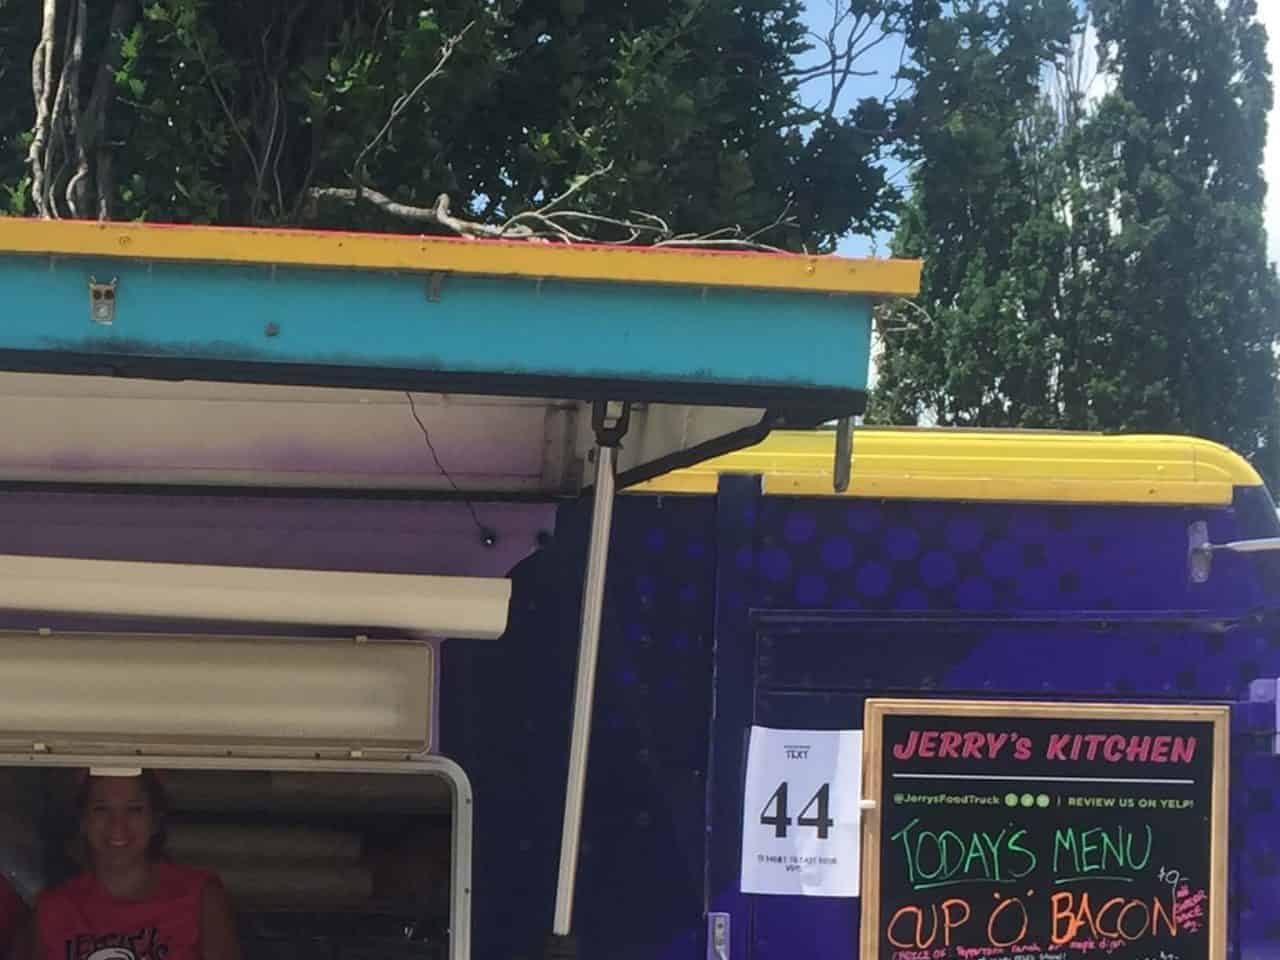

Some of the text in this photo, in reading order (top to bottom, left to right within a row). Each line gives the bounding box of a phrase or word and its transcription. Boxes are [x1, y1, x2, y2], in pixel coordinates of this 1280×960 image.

[786, 750, 809, 760] TEXT
[892, 730, 1198, 763] JERRY's KITCHEN
[760, 781, 834, 839] 44
[893, 793, 1194, 809] @JerrysFoodTruck REVIEW US ON YELP!
[891, 818, 1153, 882] TODAY'S MENU
[887, 899, 970, 949] CUP
[1051, 890, 1179, 945] BACON
